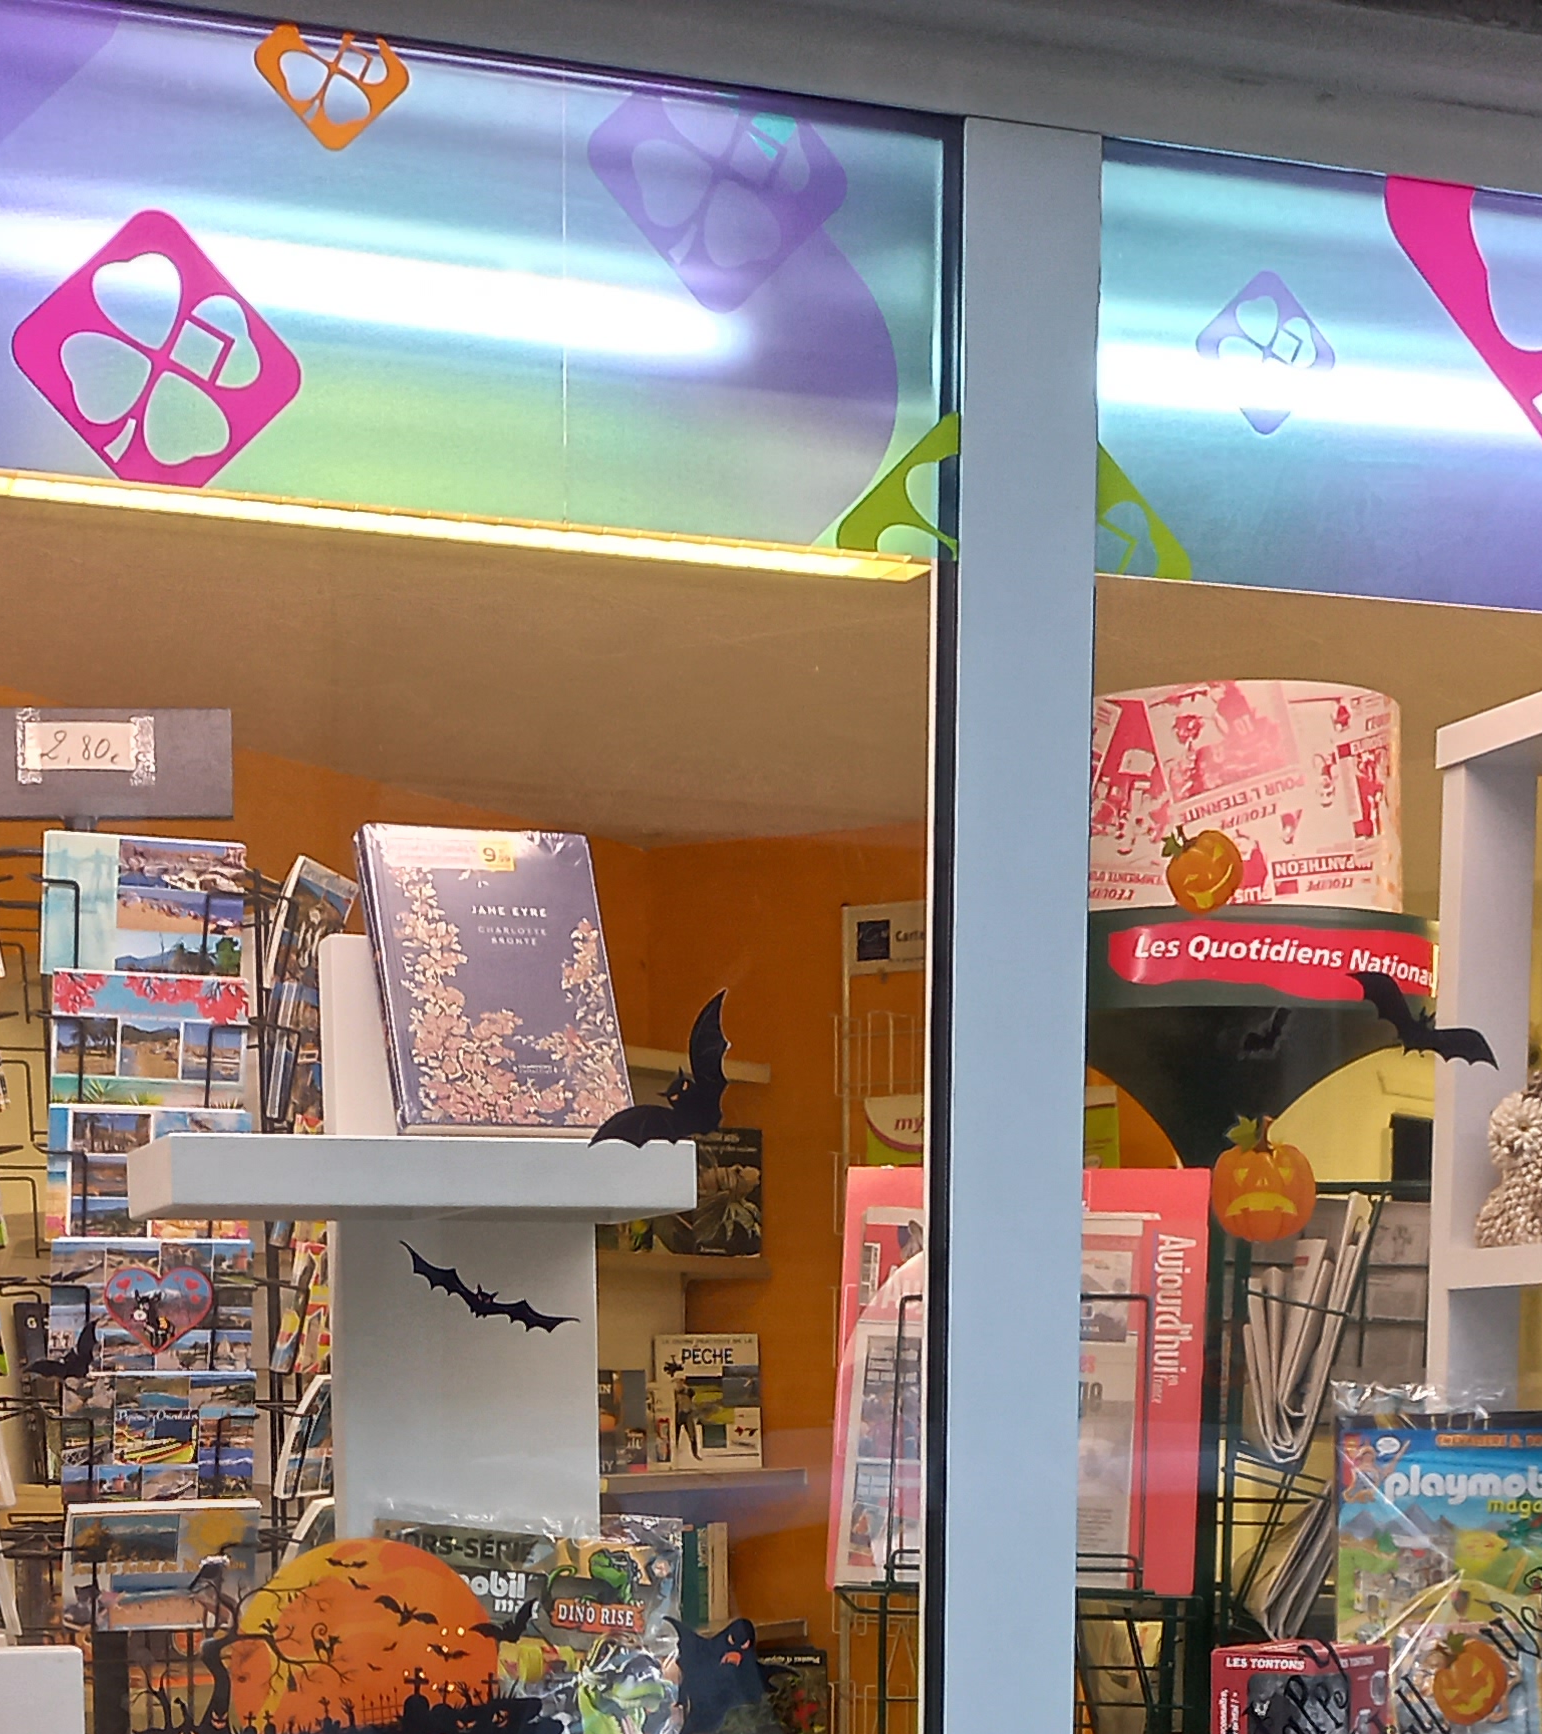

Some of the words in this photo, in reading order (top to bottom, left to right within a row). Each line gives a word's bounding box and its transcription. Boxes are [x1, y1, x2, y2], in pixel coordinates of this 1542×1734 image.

[471, 904, 506, 917] JANE
[511, 906, 548, 919] EYRE
[1134, 933, 1180, 960] Les
[1186, 934, 1343, 969] Quotidiens
[1153, 1233, 1197, 1380] Aujourd'hui
[558, 1602, 595, 1624] DINO
[602, 1607, 634, 1627] RISE
[1225, 1656, 1248, 1669] LES
[1250, 1657, 1306, 1672] TONTONS
